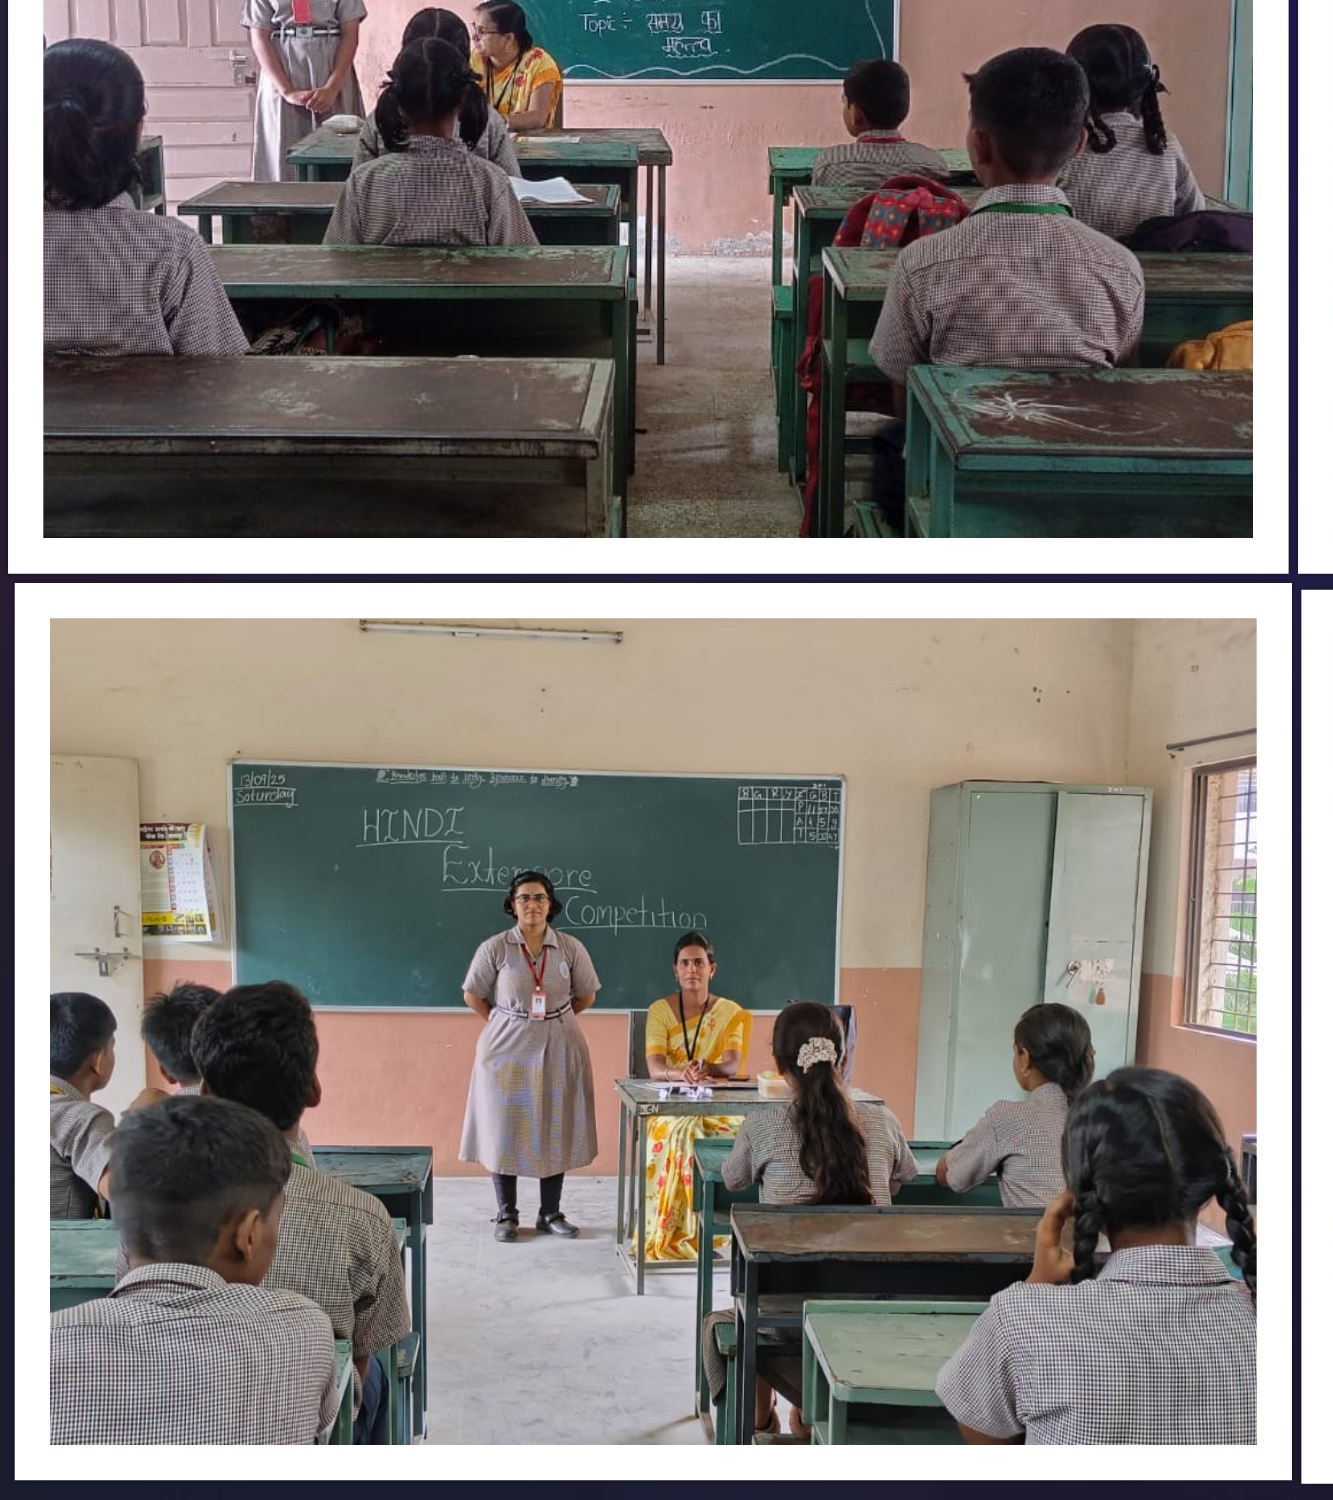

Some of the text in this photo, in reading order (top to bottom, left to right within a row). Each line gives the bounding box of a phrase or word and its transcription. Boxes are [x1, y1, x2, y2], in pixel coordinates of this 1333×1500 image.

[579, 13, 616, 37] Topic
[240, 773, 286, 787] 13/09/25
[235, 786, 297, 807] Saturday
[363, 806, 465, 843] HINDI
[564, 894, 708, 936] Competition
